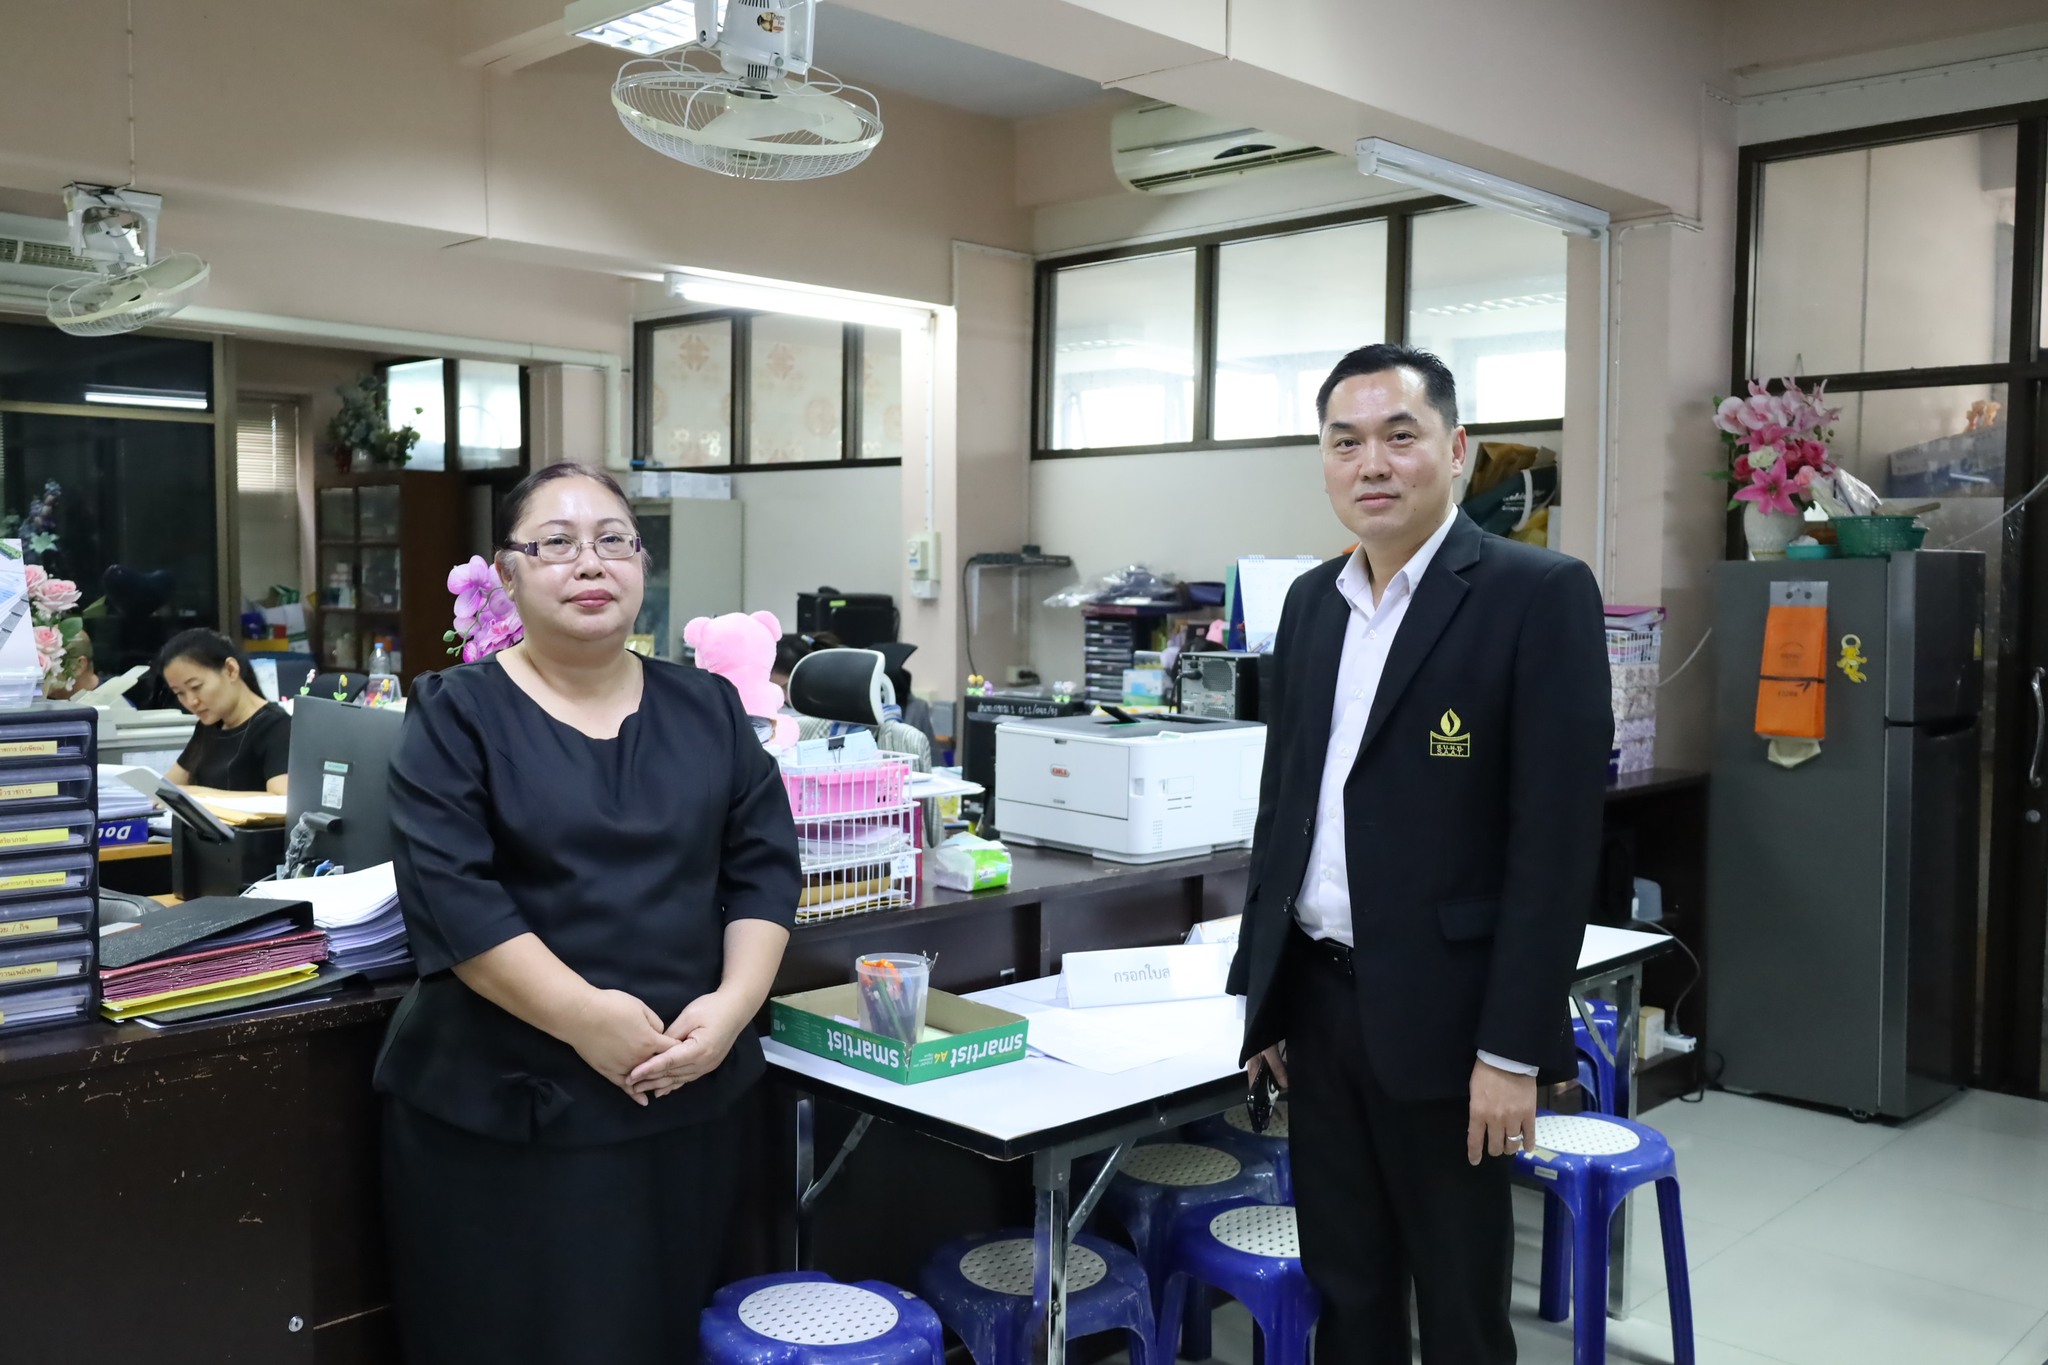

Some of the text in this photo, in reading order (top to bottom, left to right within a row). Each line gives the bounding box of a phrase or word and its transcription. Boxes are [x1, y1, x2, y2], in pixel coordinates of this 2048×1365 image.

[827, 1028, 899, 1068] smartist
[934, 1050, 949, 1065] A4
[950, 1033, 1024, 1068] smartist
